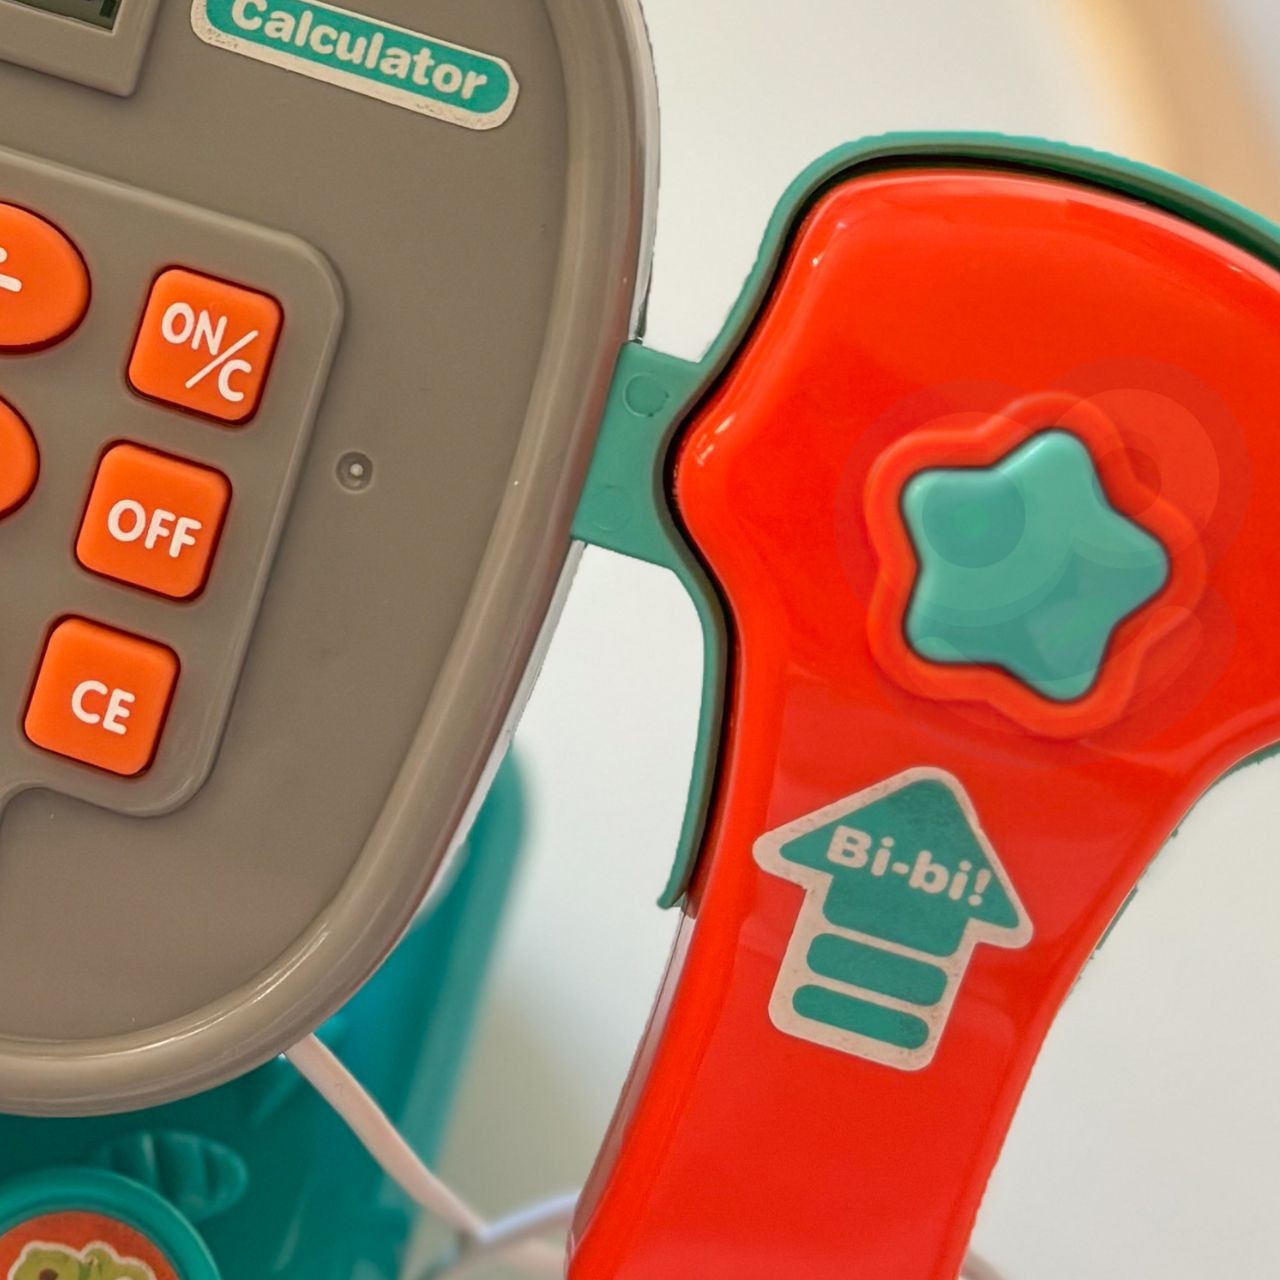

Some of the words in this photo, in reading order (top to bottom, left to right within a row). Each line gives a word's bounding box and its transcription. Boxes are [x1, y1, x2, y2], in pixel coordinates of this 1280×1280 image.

[107, 498, 202, 558] OFF
[70, 679, 136, 735] CE
[825, 824, 992, 907] Bi-bi!
